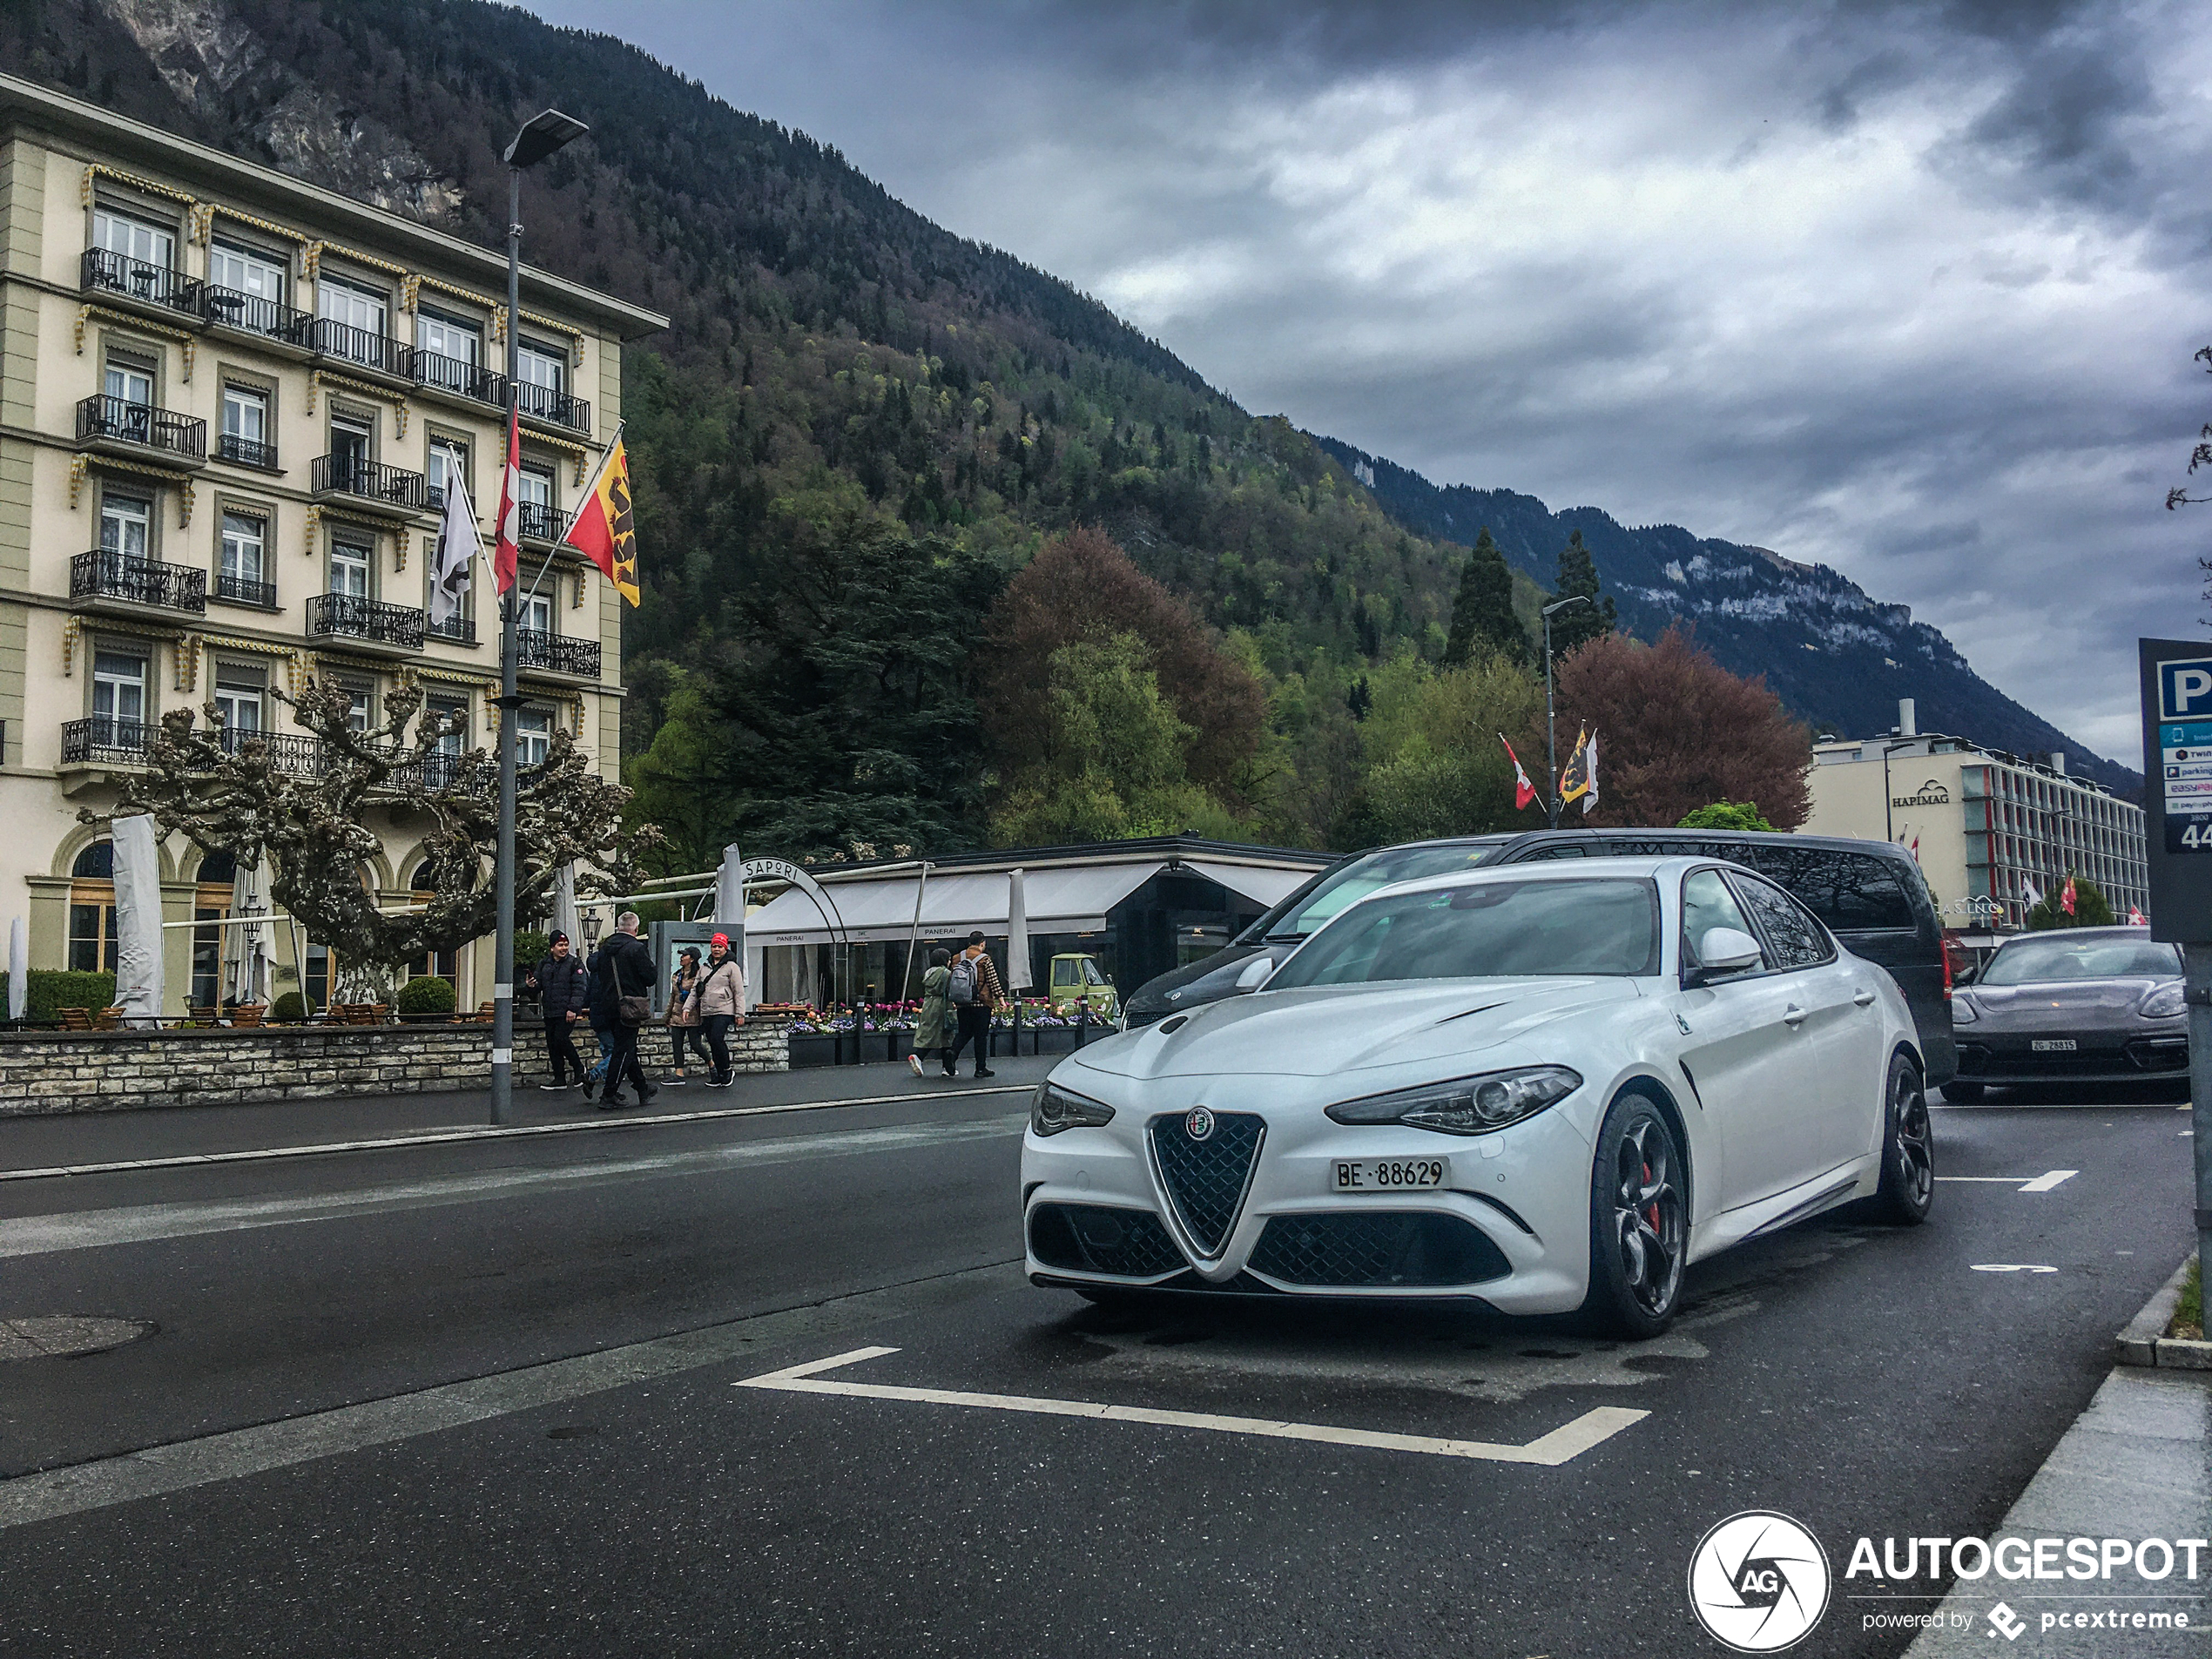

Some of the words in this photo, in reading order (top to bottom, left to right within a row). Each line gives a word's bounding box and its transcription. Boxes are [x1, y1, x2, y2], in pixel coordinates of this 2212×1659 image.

[2174, 669, 2212, 711] P
[1892, 793, 1949, 807] HAPIMAG
[745, 860, 798, 880] SAPORI
[1933, 902, 2001, 914] ASINO
[1338, 1163, 1364, 1186] BE
[1377, 1160, 1443, 1186] 88629
